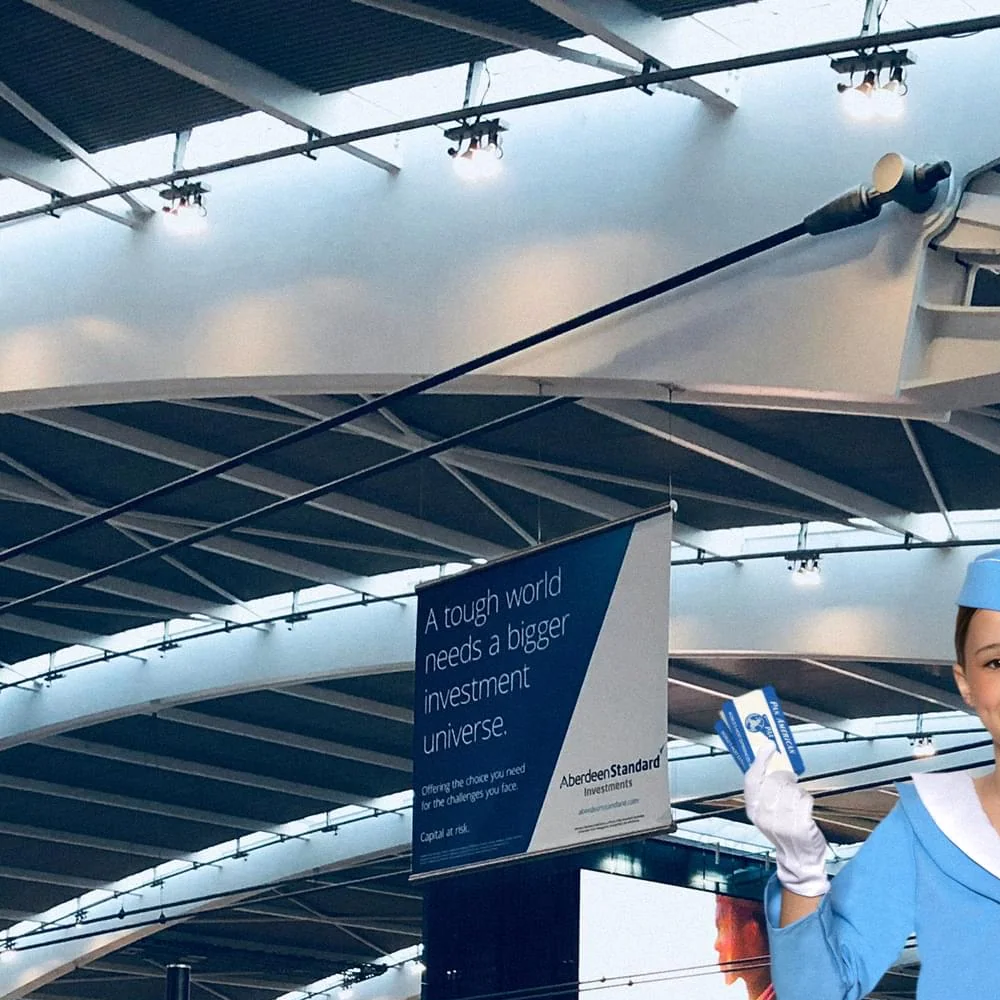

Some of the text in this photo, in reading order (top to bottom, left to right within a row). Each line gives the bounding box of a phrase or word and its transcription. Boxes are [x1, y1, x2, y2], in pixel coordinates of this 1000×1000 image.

[424, 566, 562, 635] A tough world
[425, 613, 570, 675] needs a bigger
[424, 664, 531, 715] investment
[423, 716, 508, 754] universe.
[421, 762, 526, 797] Offering the choice you need
[583, 779, 633, 797] Investments
[421, 800, 432, 812] for
[433, 797, 445, 809] the
[446, 789, 484, 803] challenges
[485, 786, 500, 800] you
[420, 827, 445, 843] Capital
[446, 827, 454, 837] at
